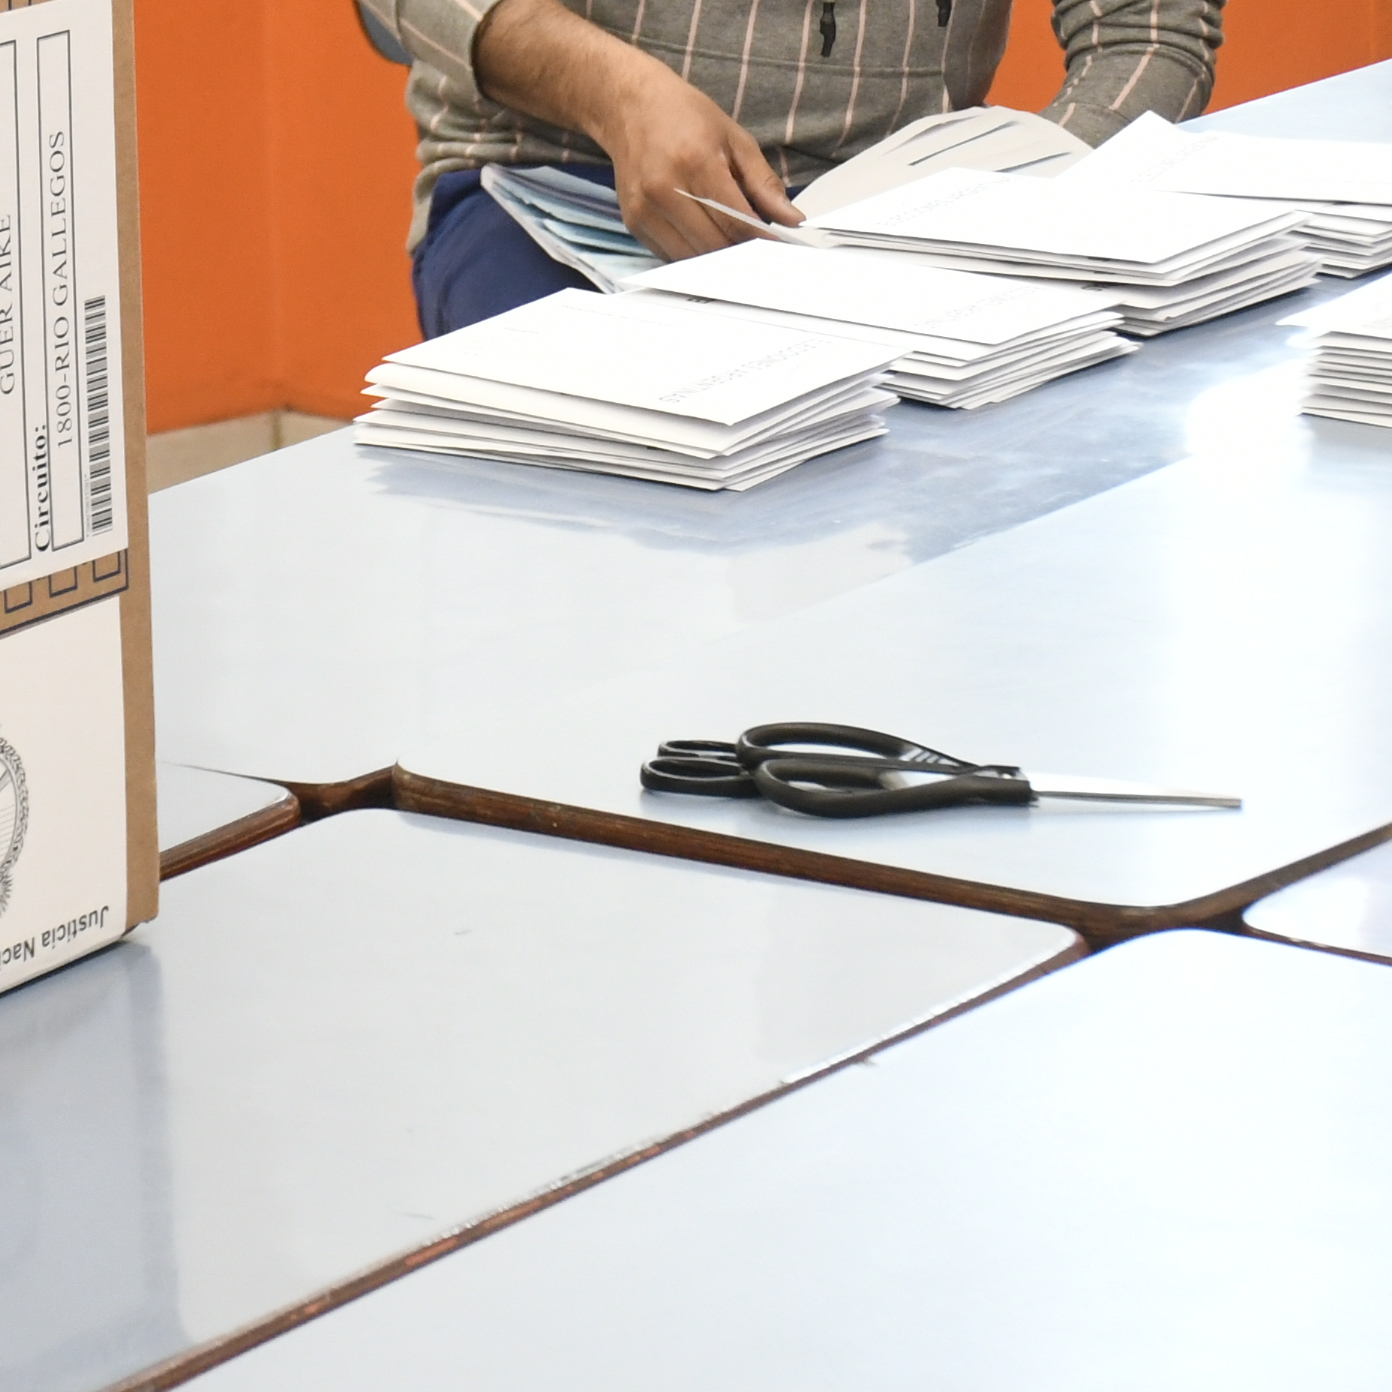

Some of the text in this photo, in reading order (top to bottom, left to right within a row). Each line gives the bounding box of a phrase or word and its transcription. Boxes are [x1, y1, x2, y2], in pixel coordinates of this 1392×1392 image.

[32, 130, 73, 552] Circuito: 1800-RIO GALLEGOS
[41, 905, 110, 950] Justicia
